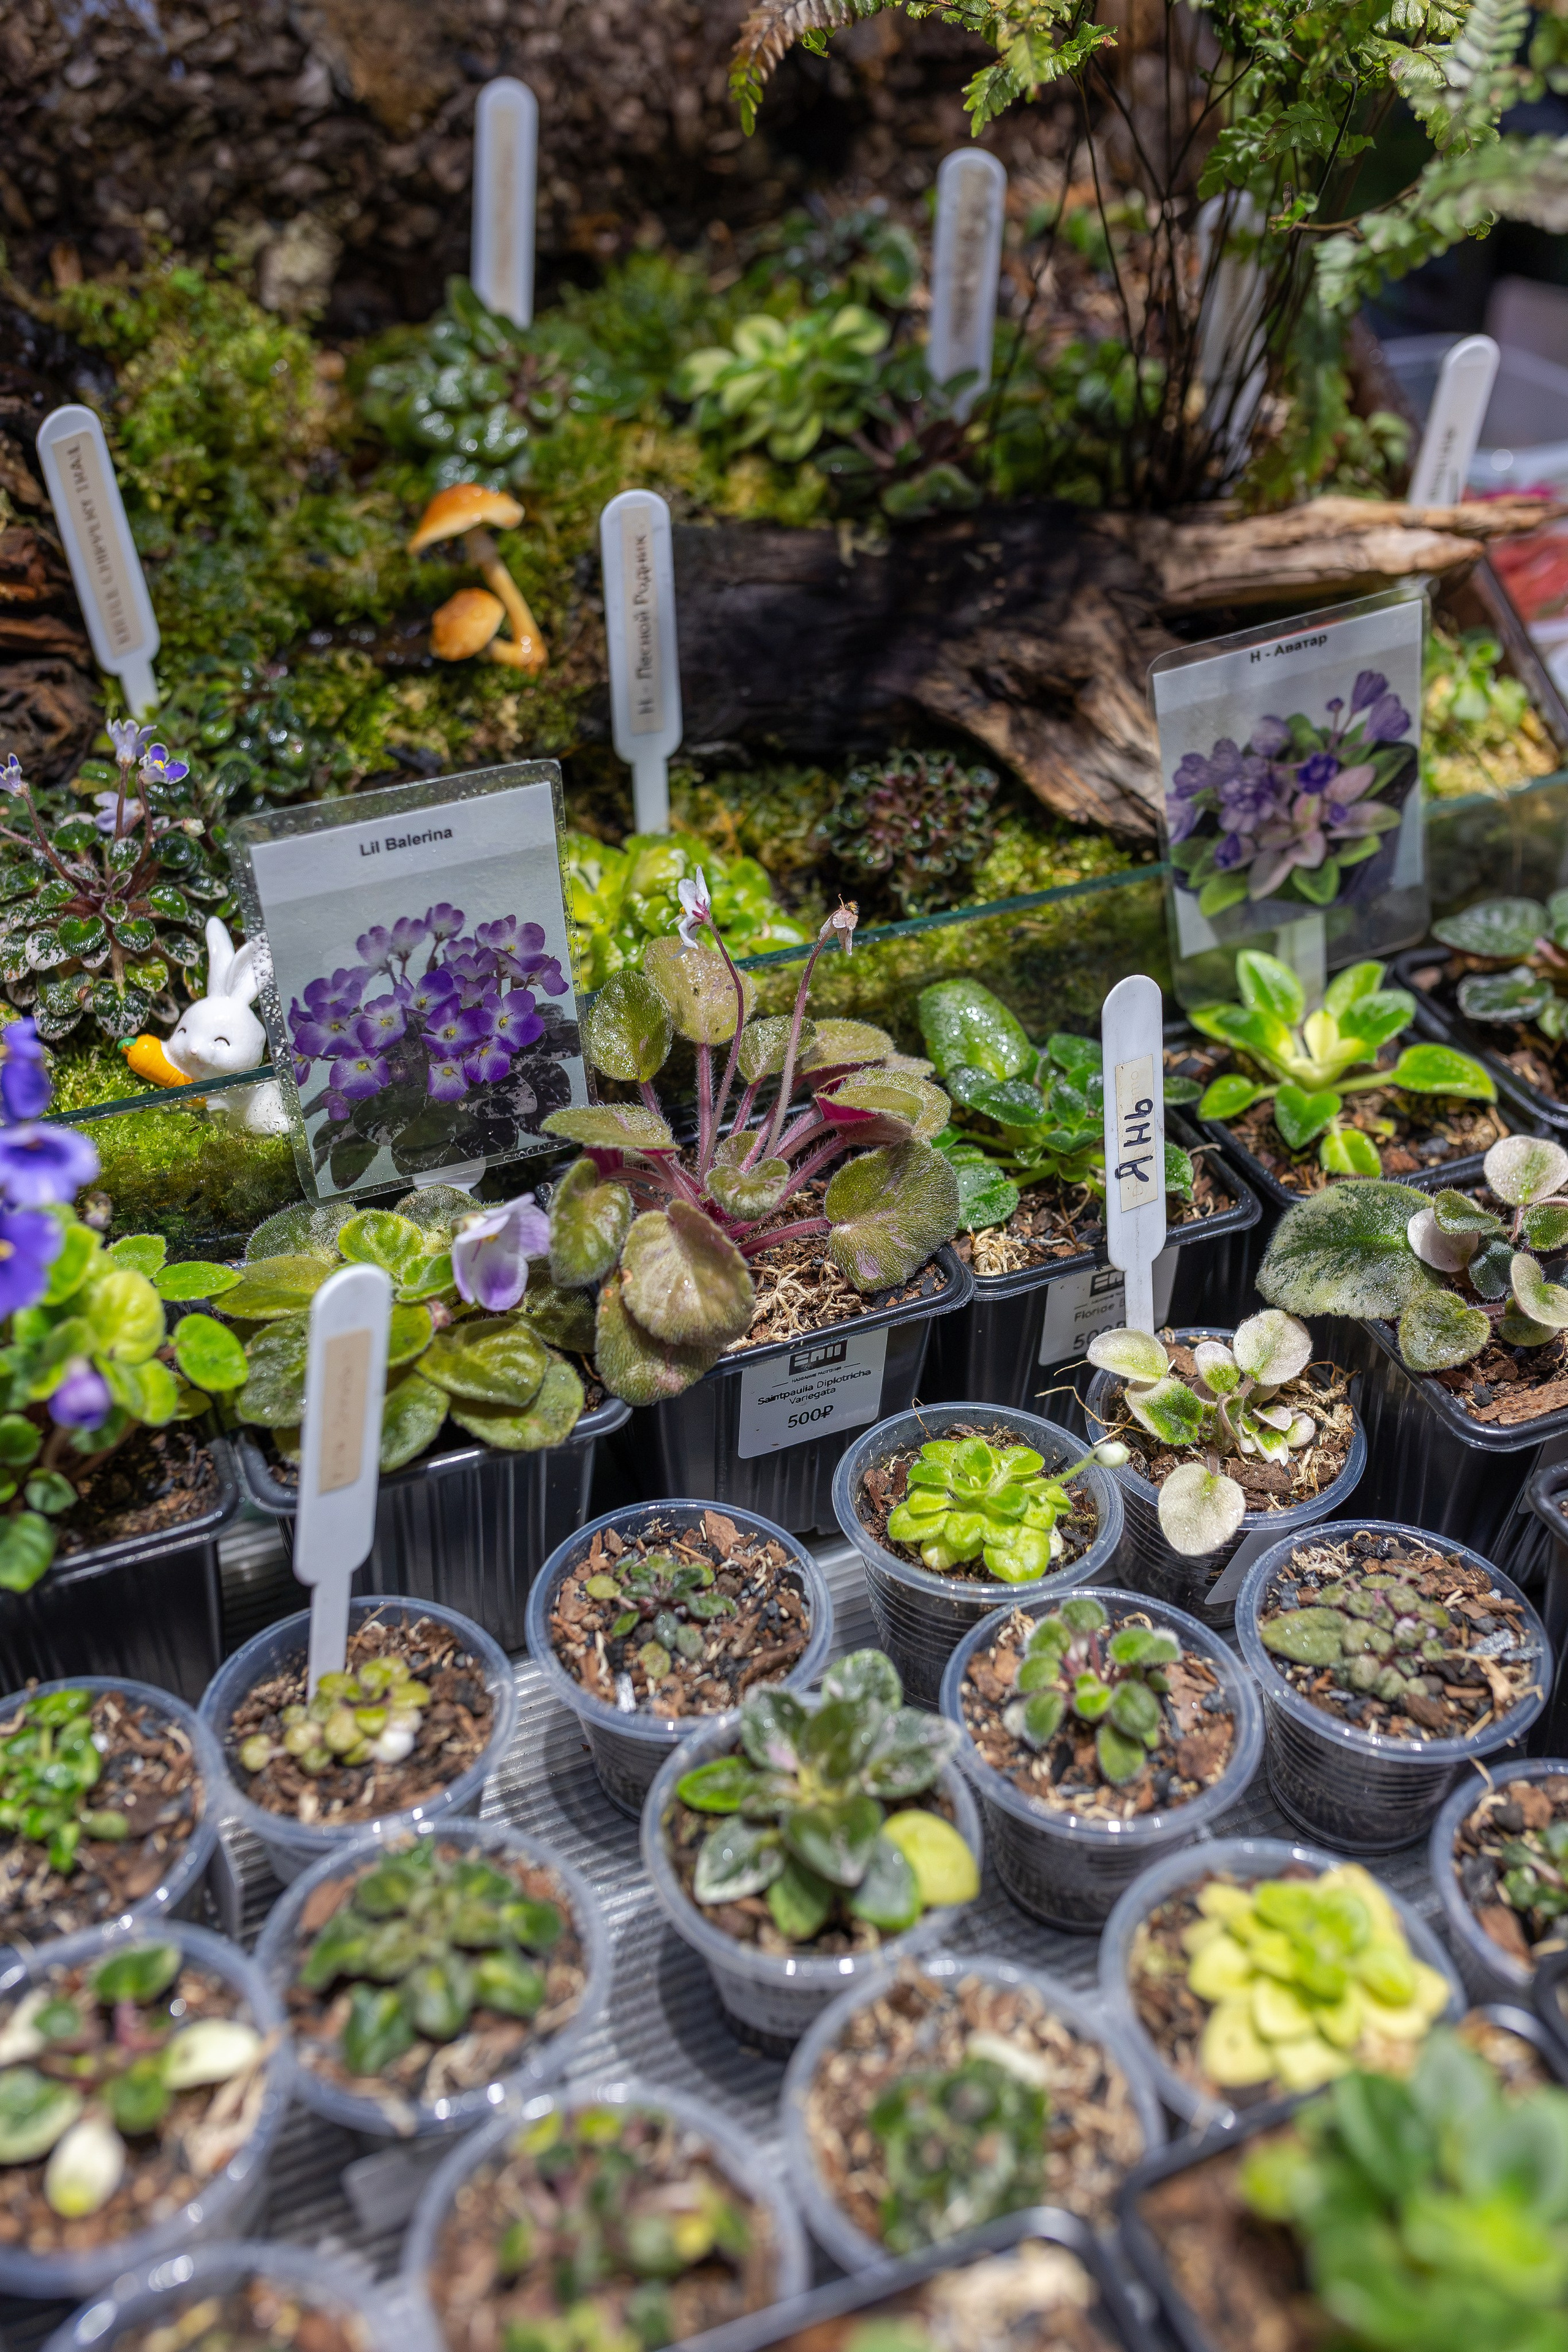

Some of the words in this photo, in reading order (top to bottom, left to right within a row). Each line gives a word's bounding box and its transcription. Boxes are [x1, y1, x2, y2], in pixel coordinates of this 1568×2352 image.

[1275, 635, 1327, 657] Аватар
[360, 840, 380, 856] Lil
[385, 828, 453, 851] Balerina
[758, 1384, 814, 1405] Saintpaulia
[816, 1368, 872, 1389] Diplotricha
[790, 1387, 836, 1404] Variegata
